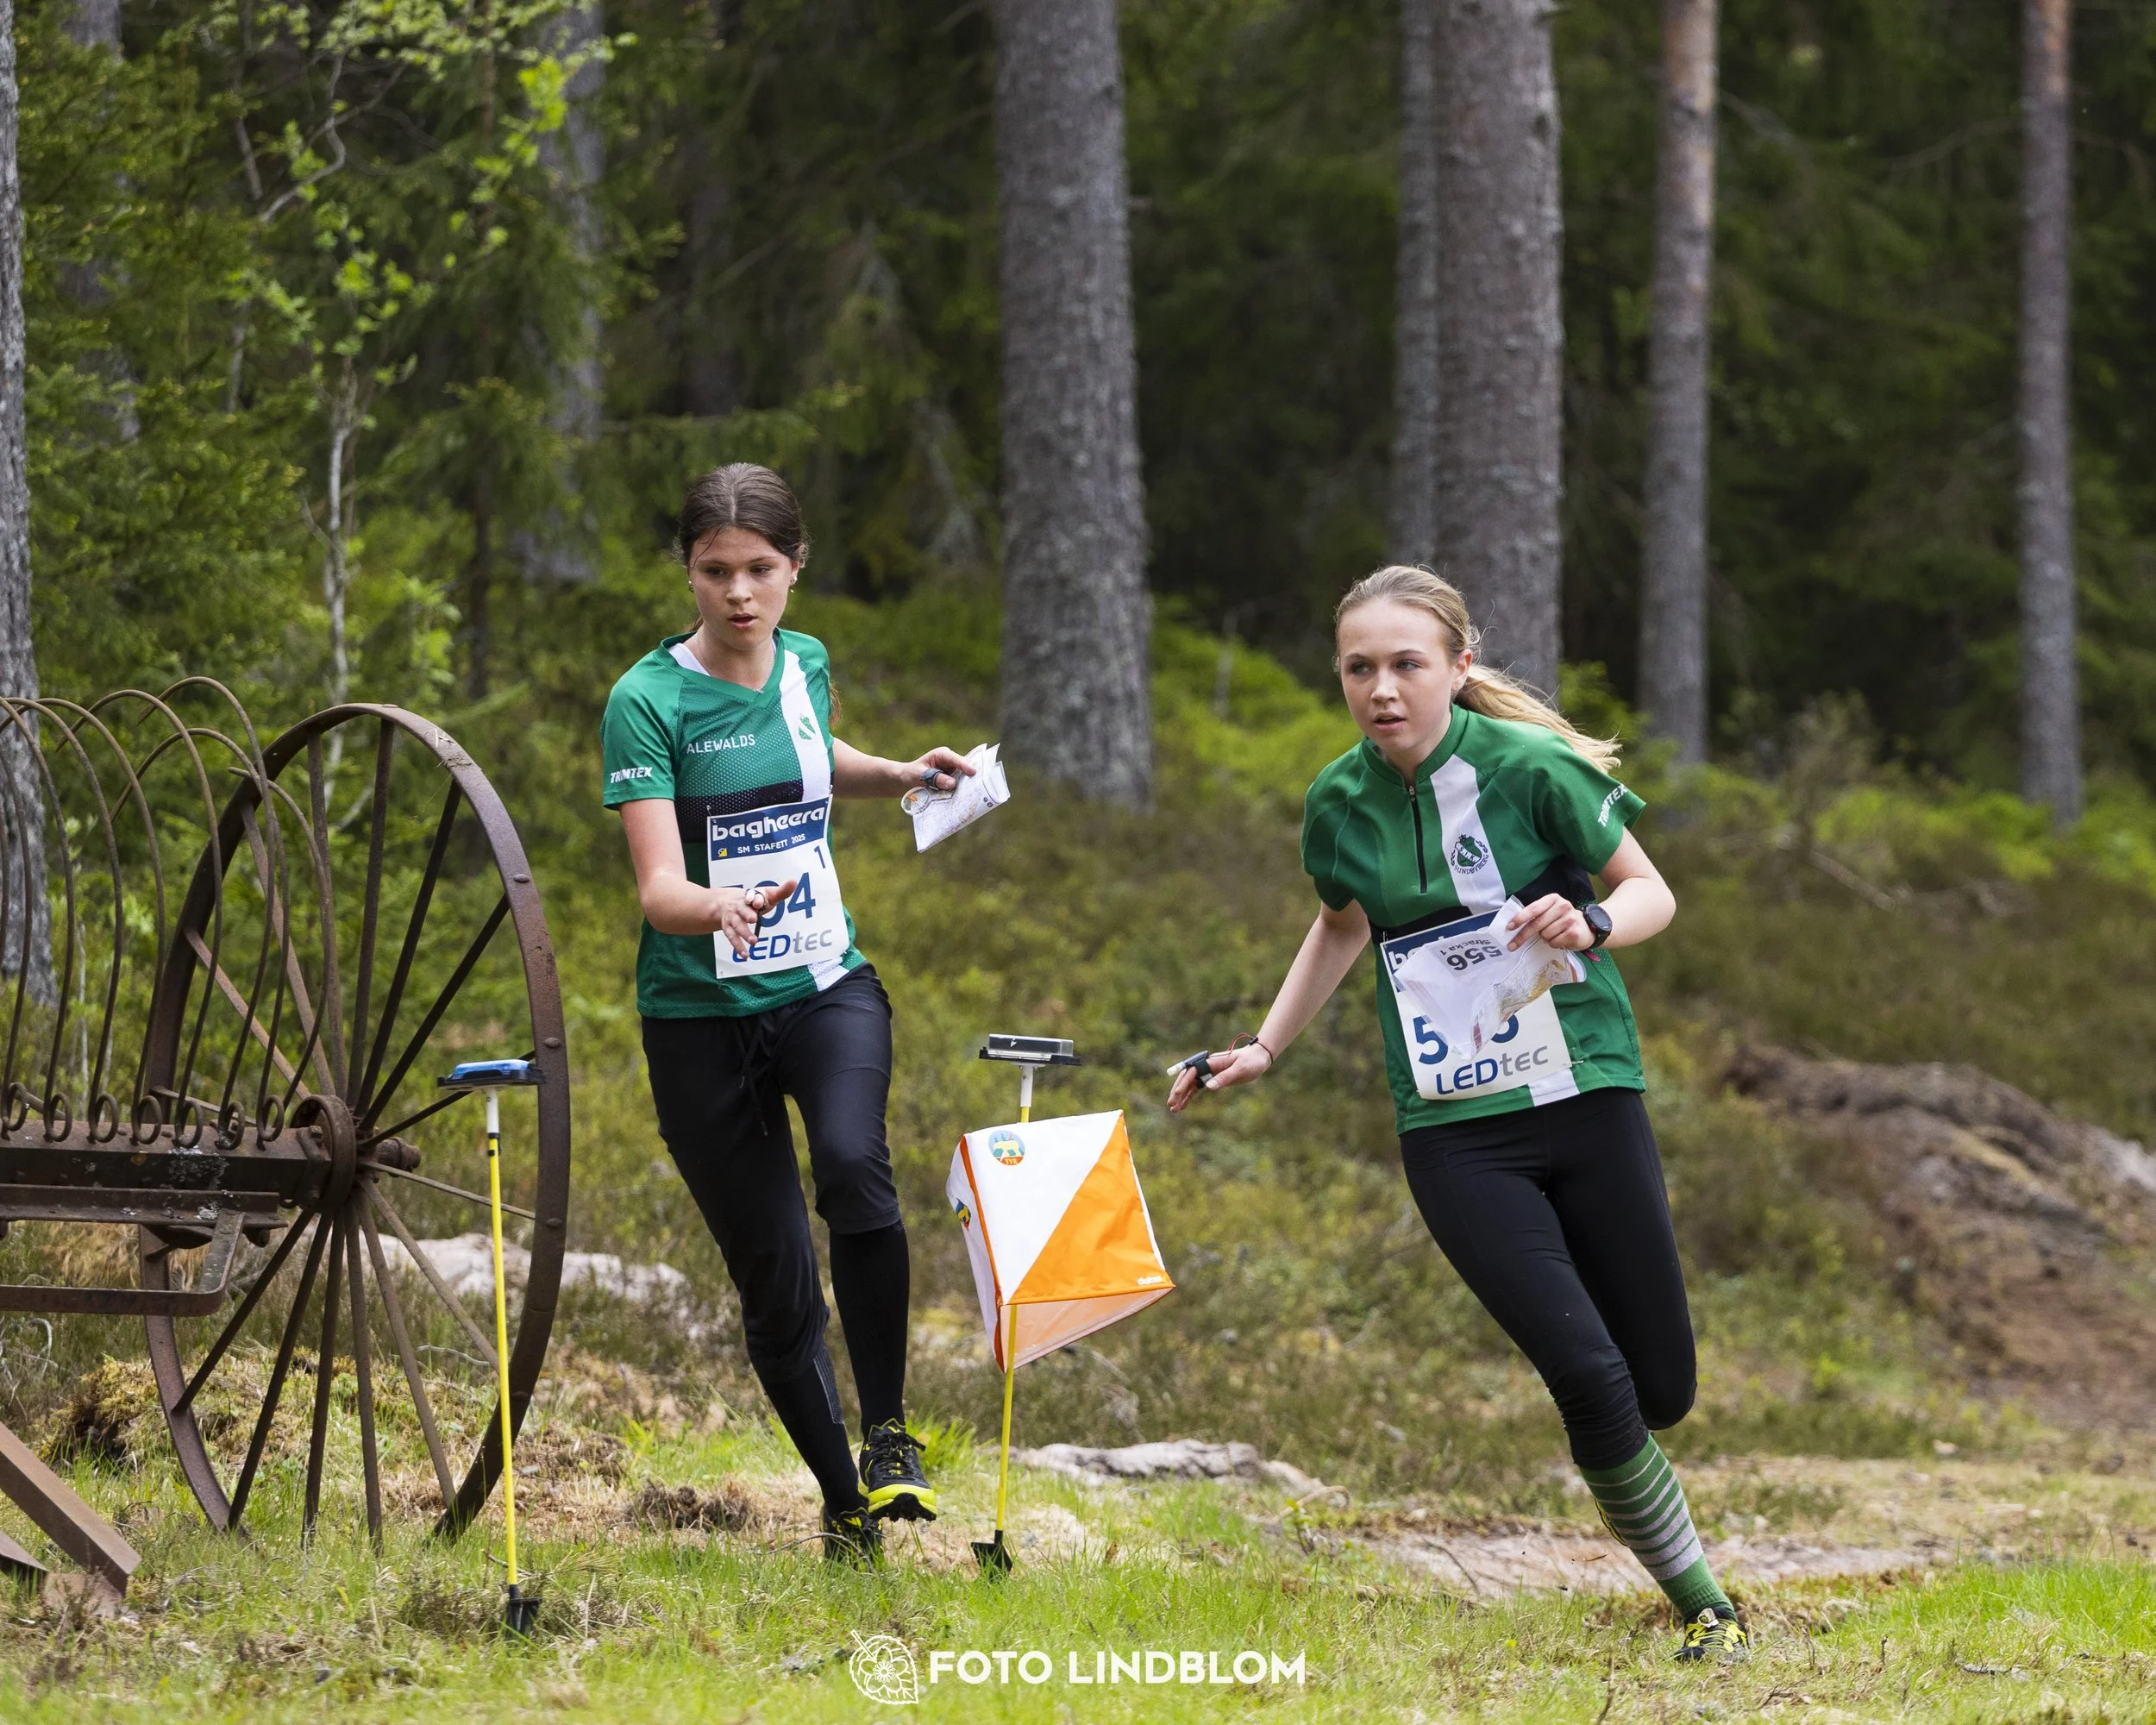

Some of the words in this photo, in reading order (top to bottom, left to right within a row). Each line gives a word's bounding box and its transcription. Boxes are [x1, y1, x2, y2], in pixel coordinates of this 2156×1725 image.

[686, 733, 756, 754] ALEWALDS
[712, 806, 825, 842] bagheera
[737, 845, 750, 854] SM
[755, 839, 788, 852] STAFETT
[791, 833, 805, 844] 2025
[813, 845, 826, 869] 1
[1449, 938, 1491, 951] Stracka
[1446, 945, 1503, 971] 556
[1436, 1045, 1548, 1095] LEDtec
